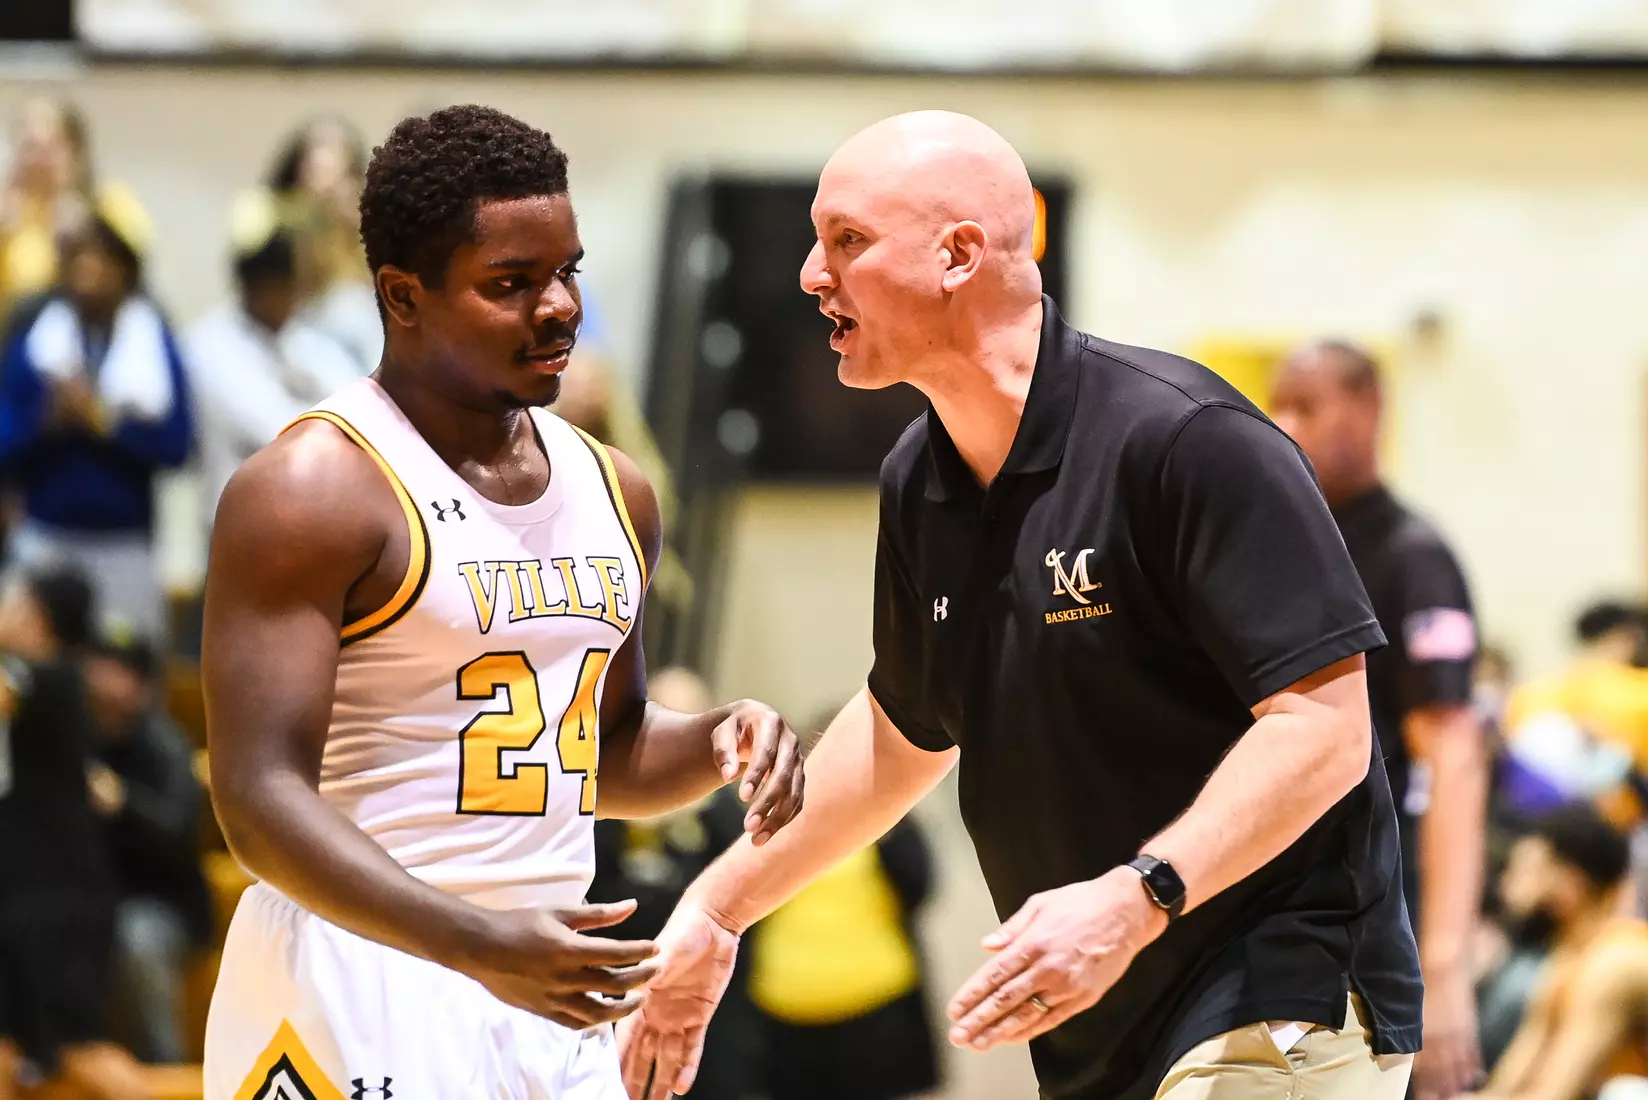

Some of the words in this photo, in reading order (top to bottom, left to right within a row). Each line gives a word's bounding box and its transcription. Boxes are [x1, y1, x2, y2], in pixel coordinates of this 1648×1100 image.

[457, 556, 632, 636] VILLE
[1045, 548, 1098, 604] M
[1045, 603, 1113, 624] BASKETBALL
[456, 648, 611, 816] 24
